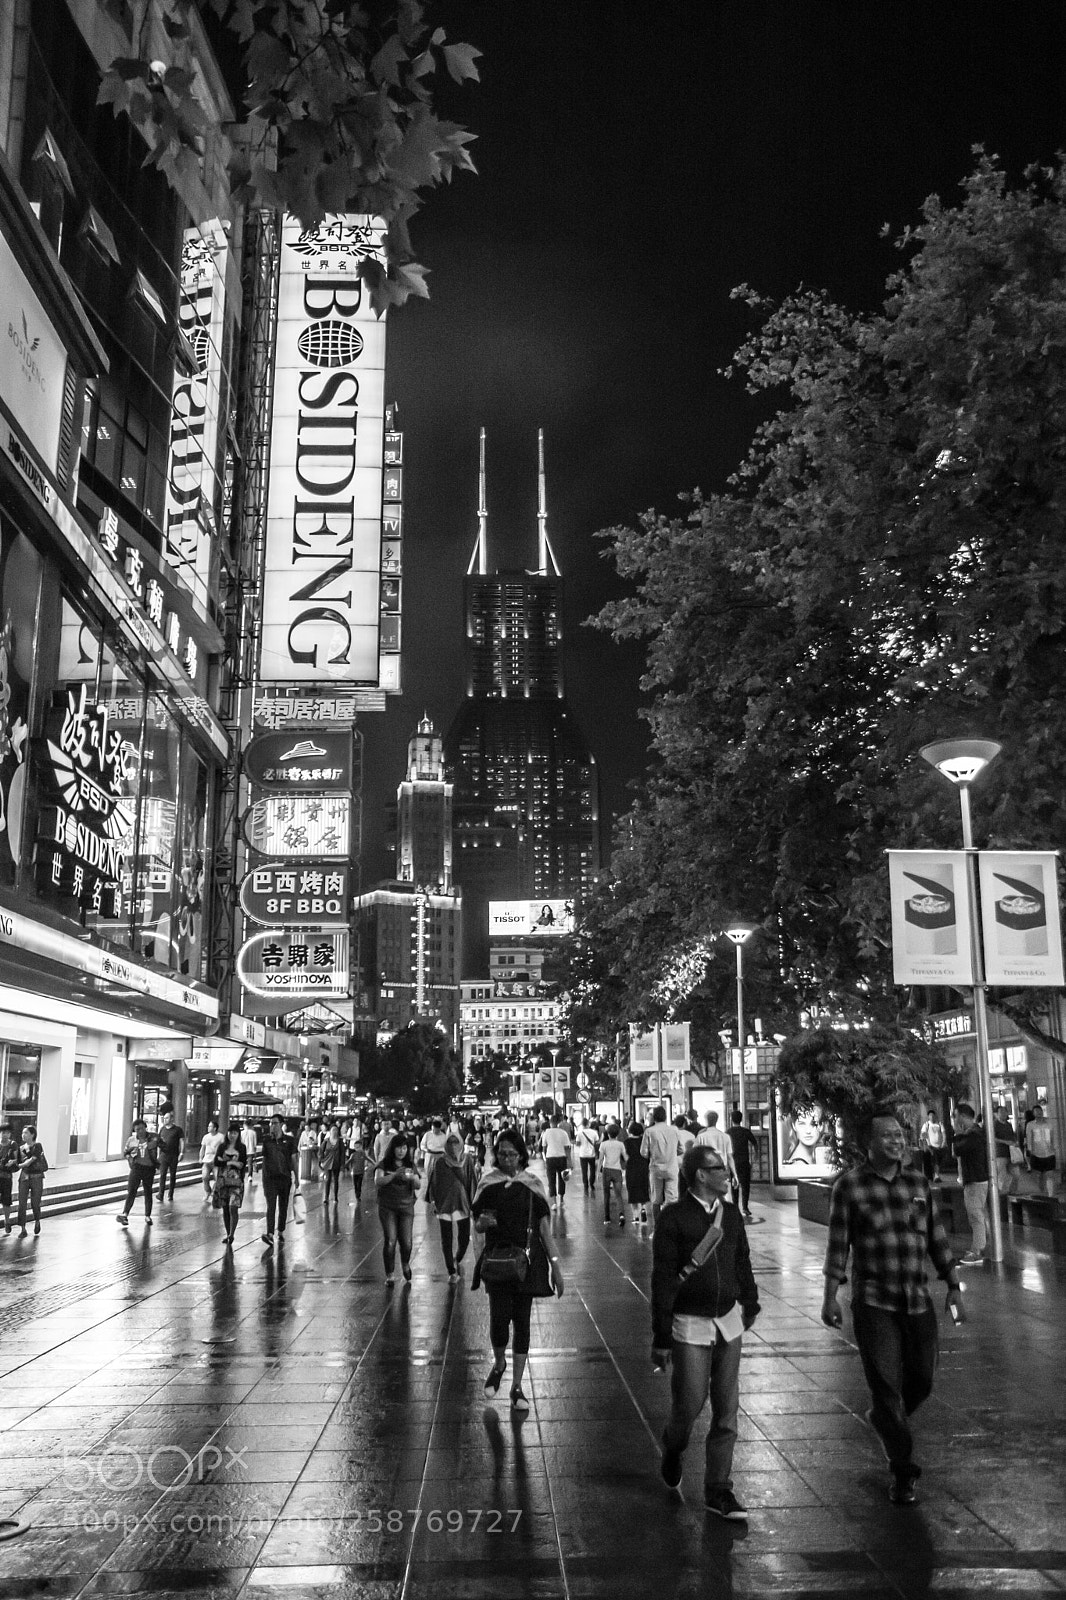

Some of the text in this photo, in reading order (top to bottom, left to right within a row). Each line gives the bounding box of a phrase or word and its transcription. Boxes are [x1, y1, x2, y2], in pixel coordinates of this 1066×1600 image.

[301, 260, 361, 270] 世界名
[287, 273, 364, 668] BOSIDENG
[382, 520, 399, 531] TV
[254, 697, 356, 720] 寿司居酒屋
[80, 778, 108, 814] BSD
[54, 806, 125, 883] BOSIDENG
[252, 871, 345, 896] 巴西烤肉
[266, 899, 342, 914] 8F BBQ
[261, 943, 336, 968] 吉野家
[265, 974, 333, 985] YOSHINOYA
